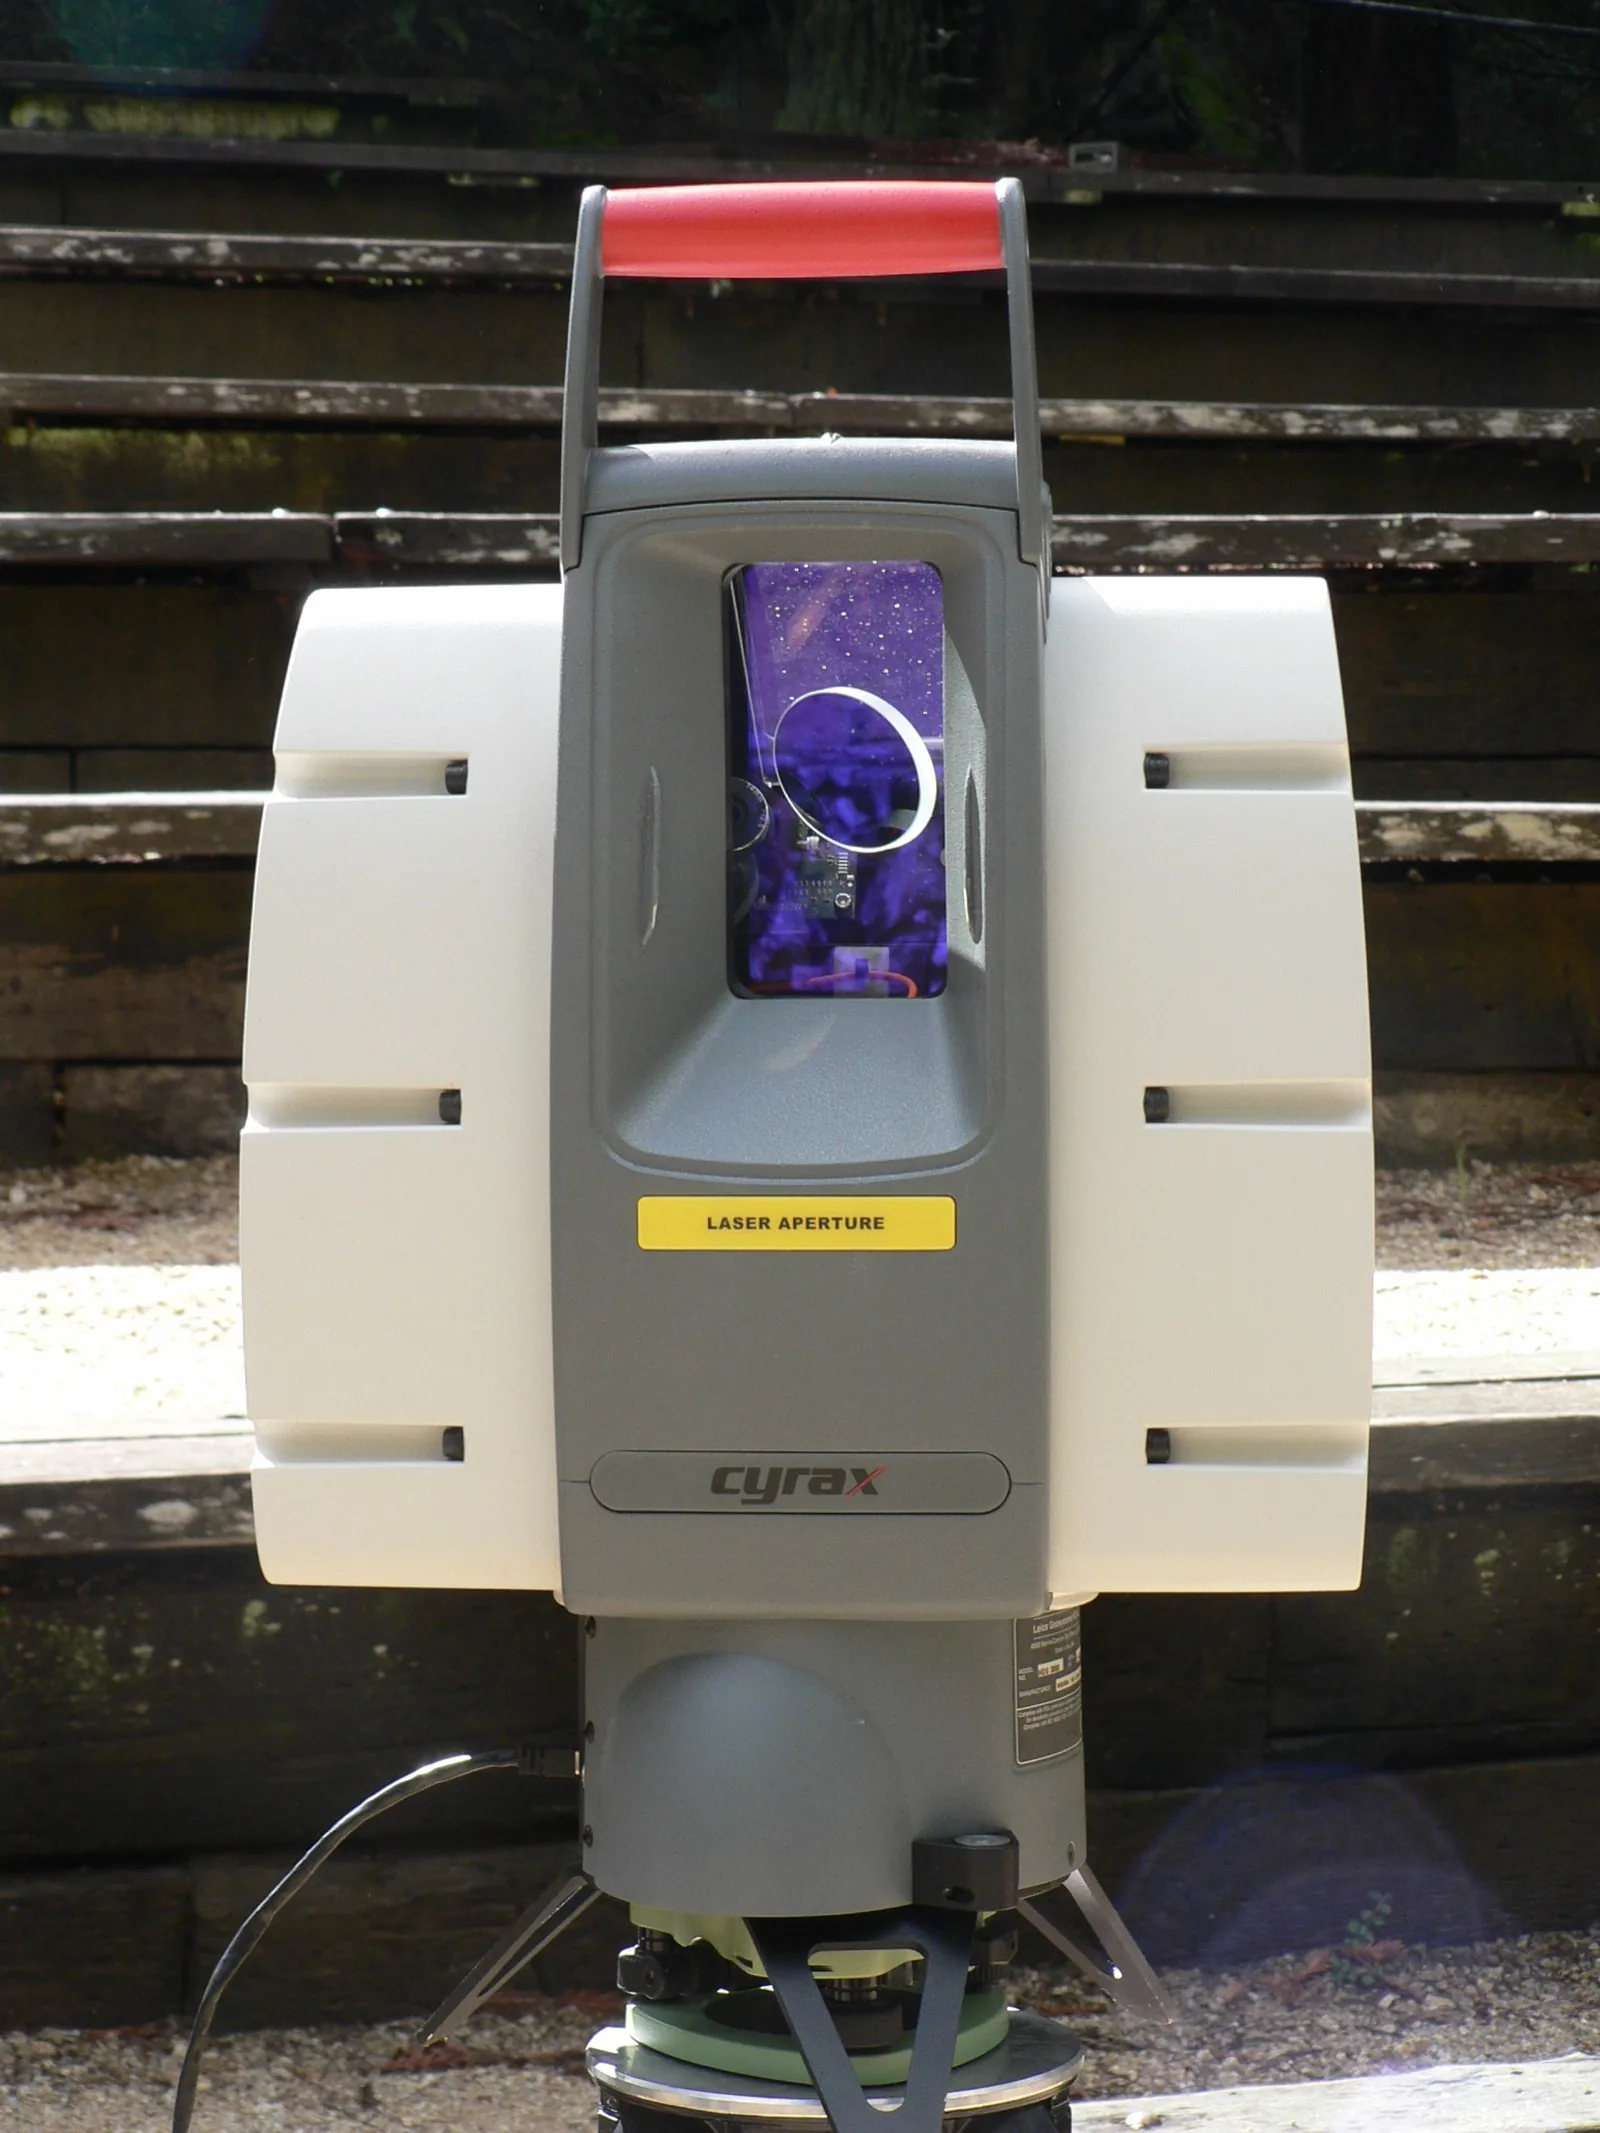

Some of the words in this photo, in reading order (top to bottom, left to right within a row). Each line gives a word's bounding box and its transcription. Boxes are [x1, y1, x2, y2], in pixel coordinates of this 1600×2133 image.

[707, 1216, 771, 1230] LASER
[778, 1216, 885, 1230] APERTURE
[710, 1465, 887, 1506] cyrax
